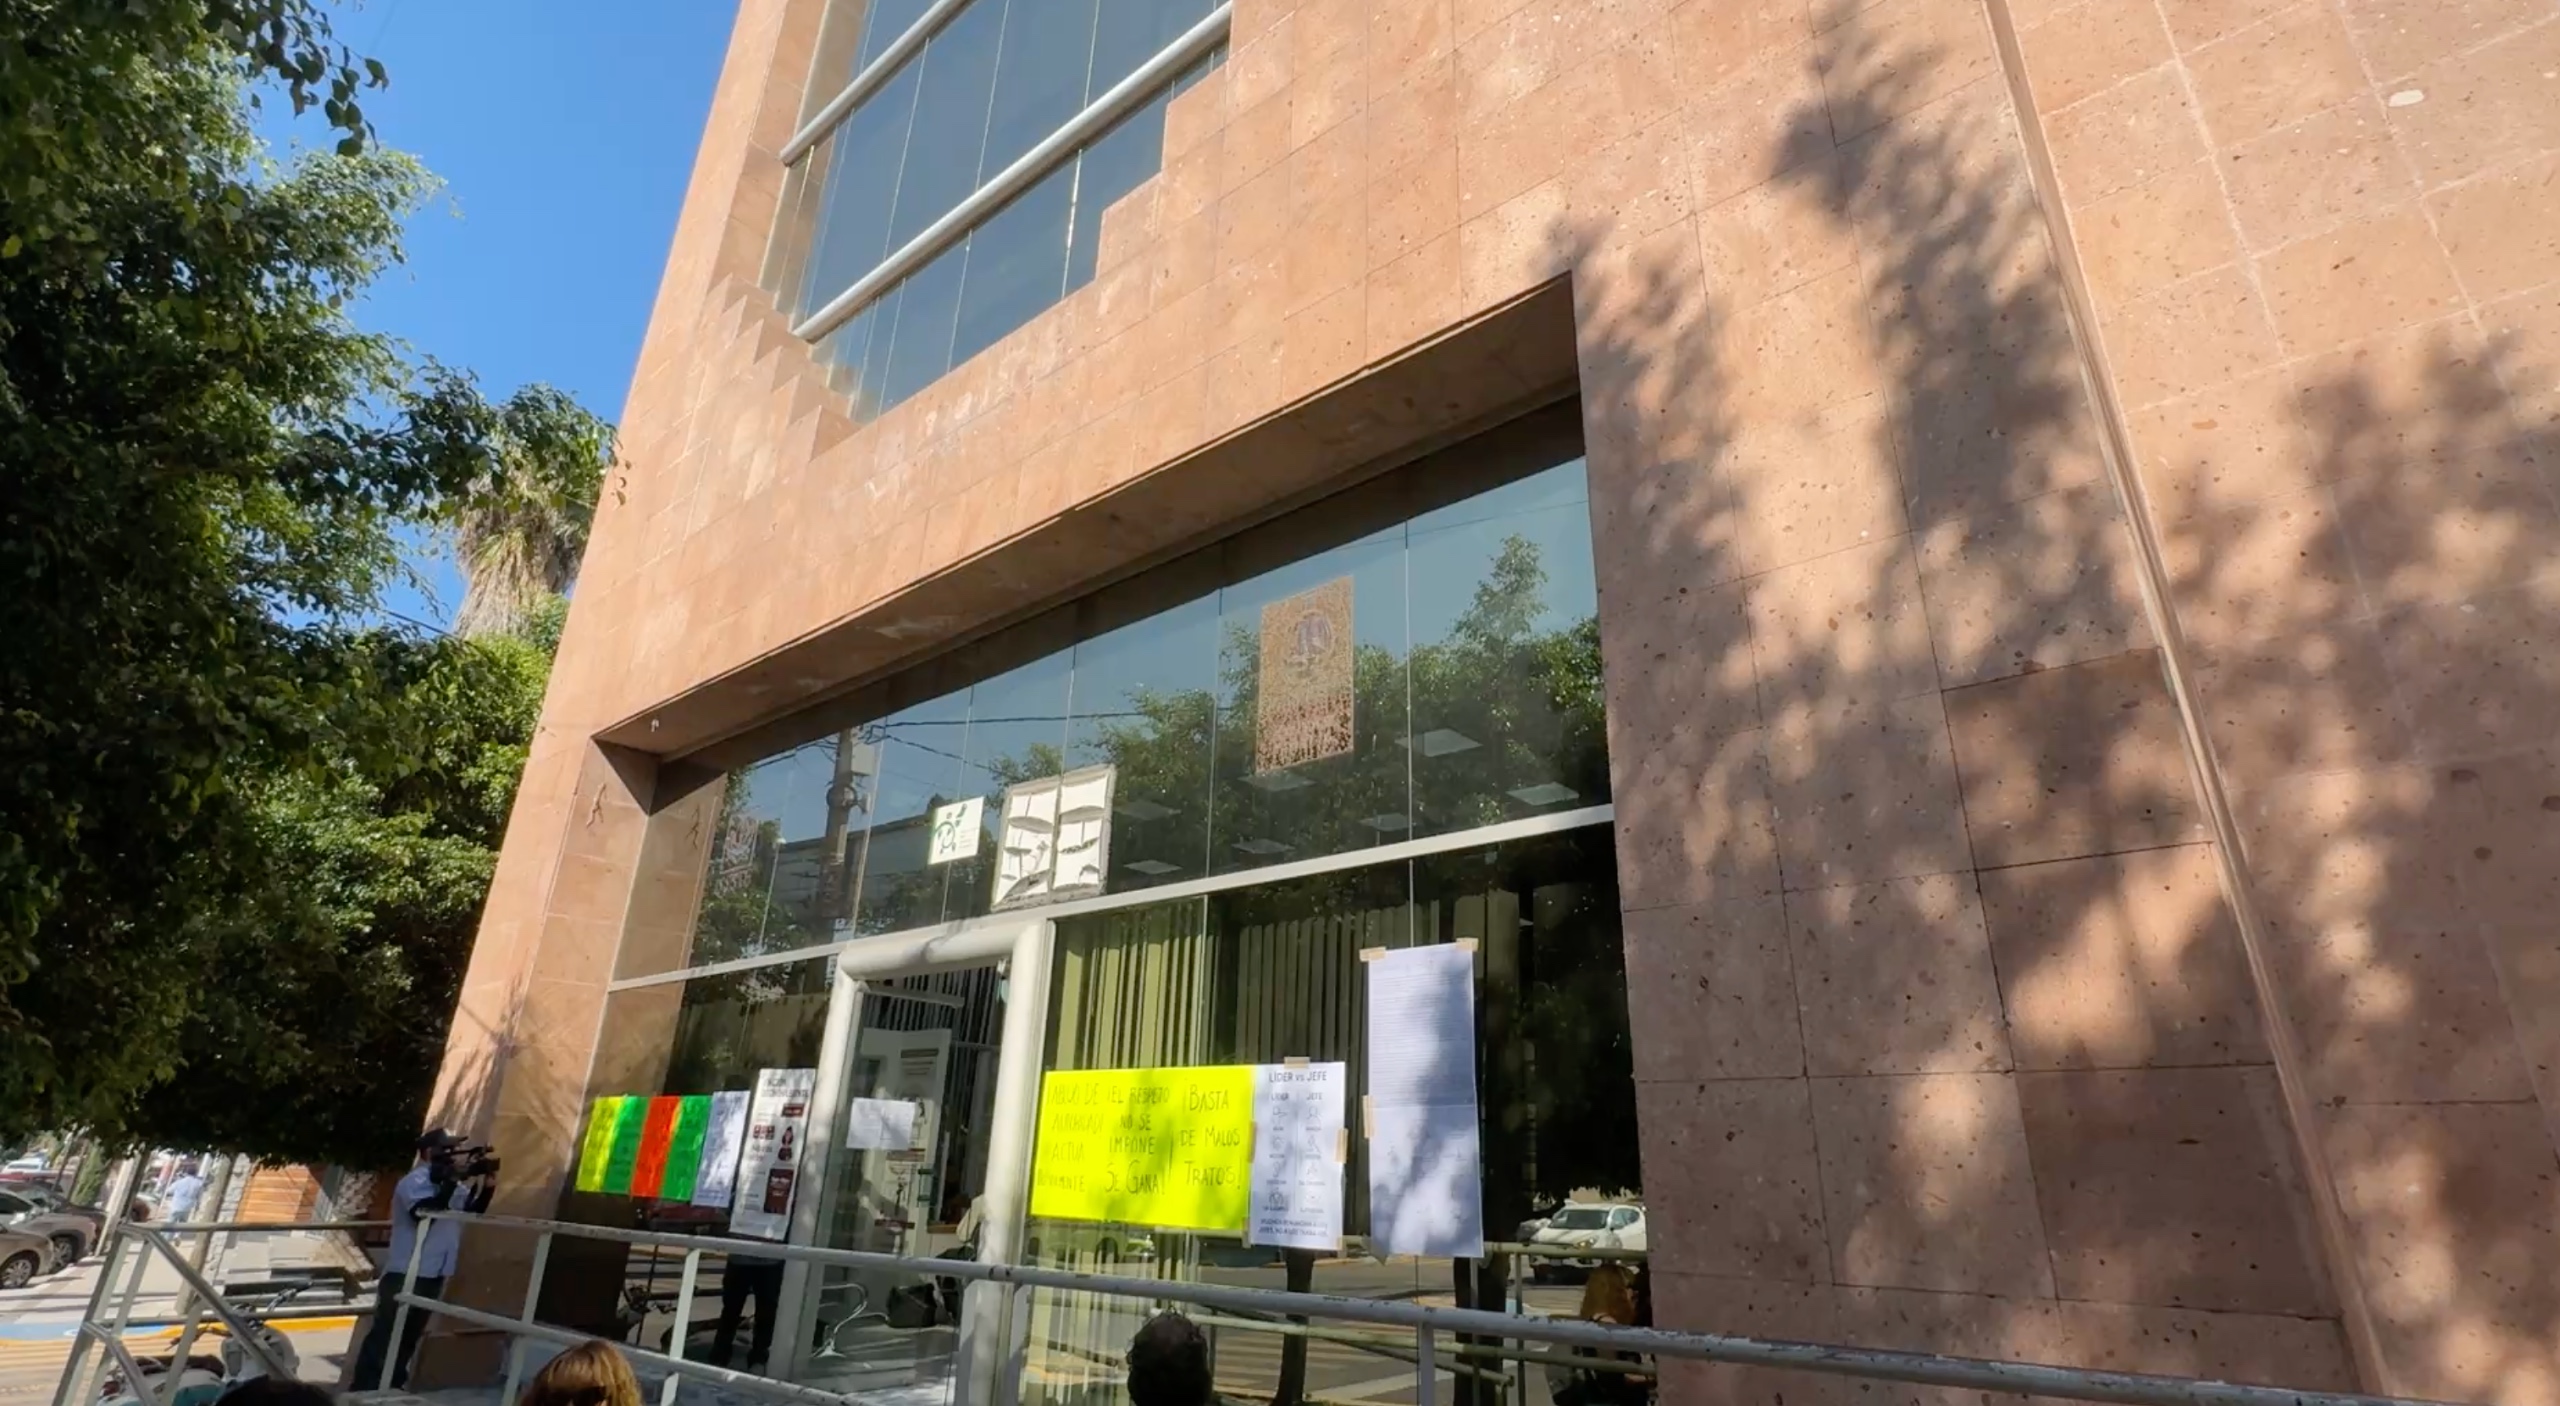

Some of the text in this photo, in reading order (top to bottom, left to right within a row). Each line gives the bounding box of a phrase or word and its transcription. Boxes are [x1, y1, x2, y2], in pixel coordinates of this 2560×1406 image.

[1306, 1071, 1327, 1082] JEFE
[1084, 1083, 1099, 1105] DE
[1129, 1086, 1170, 1104] RESPETO
[1120, 1113, 1152, 1131] NO SE
[1109, 1136, 1155, 1155] IMPONE
[1180, 1125, 1241, 1148] DE MALOS
